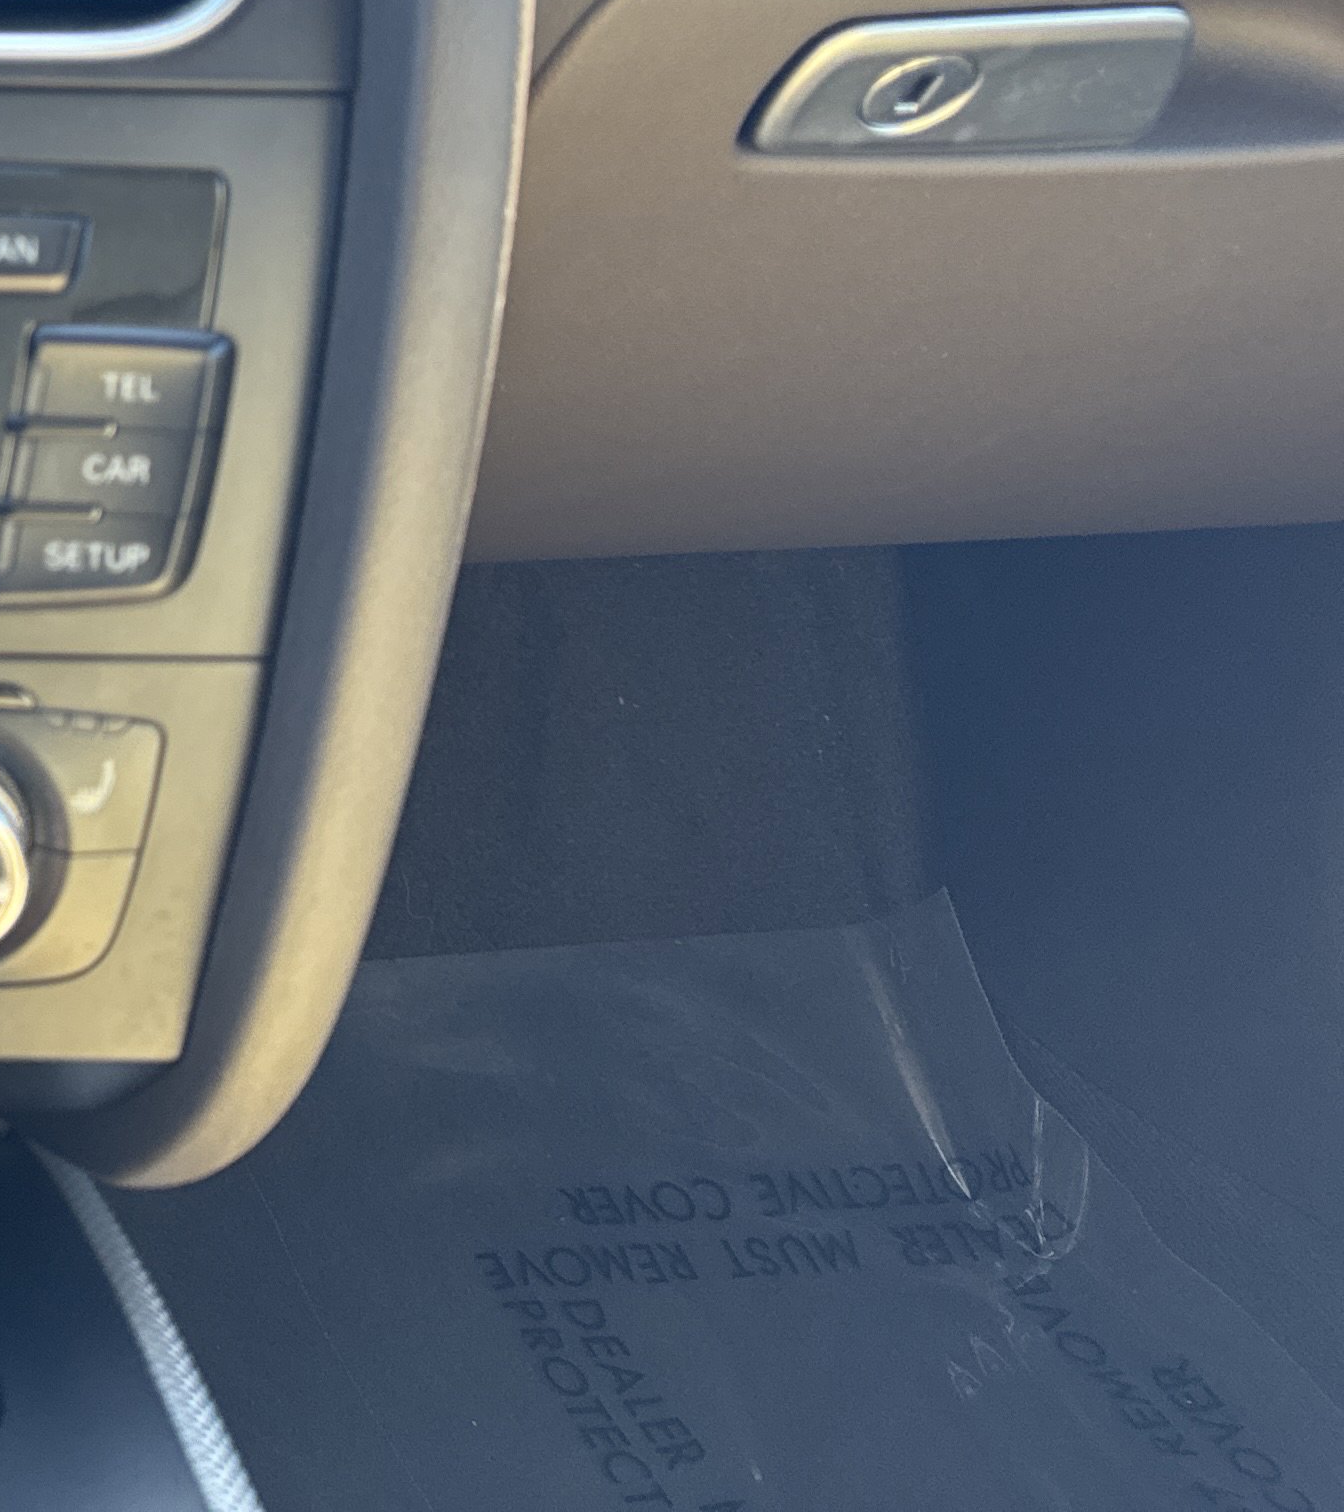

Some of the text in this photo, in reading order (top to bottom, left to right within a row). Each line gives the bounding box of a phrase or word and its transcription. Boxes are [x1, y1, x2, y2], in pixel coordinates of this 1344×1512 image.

[100, 371, 160, 403] TEL
[82, 453, 151, 485] CAR
[42, 541, 151, 573] SETUP
[559, 1175, 732, 1227] COVER
[474, 1241, 699, 1289] REMOVE
[721, 1229, 862, 1279] MUST
[562, 1298, 706, 1472] DEALER
